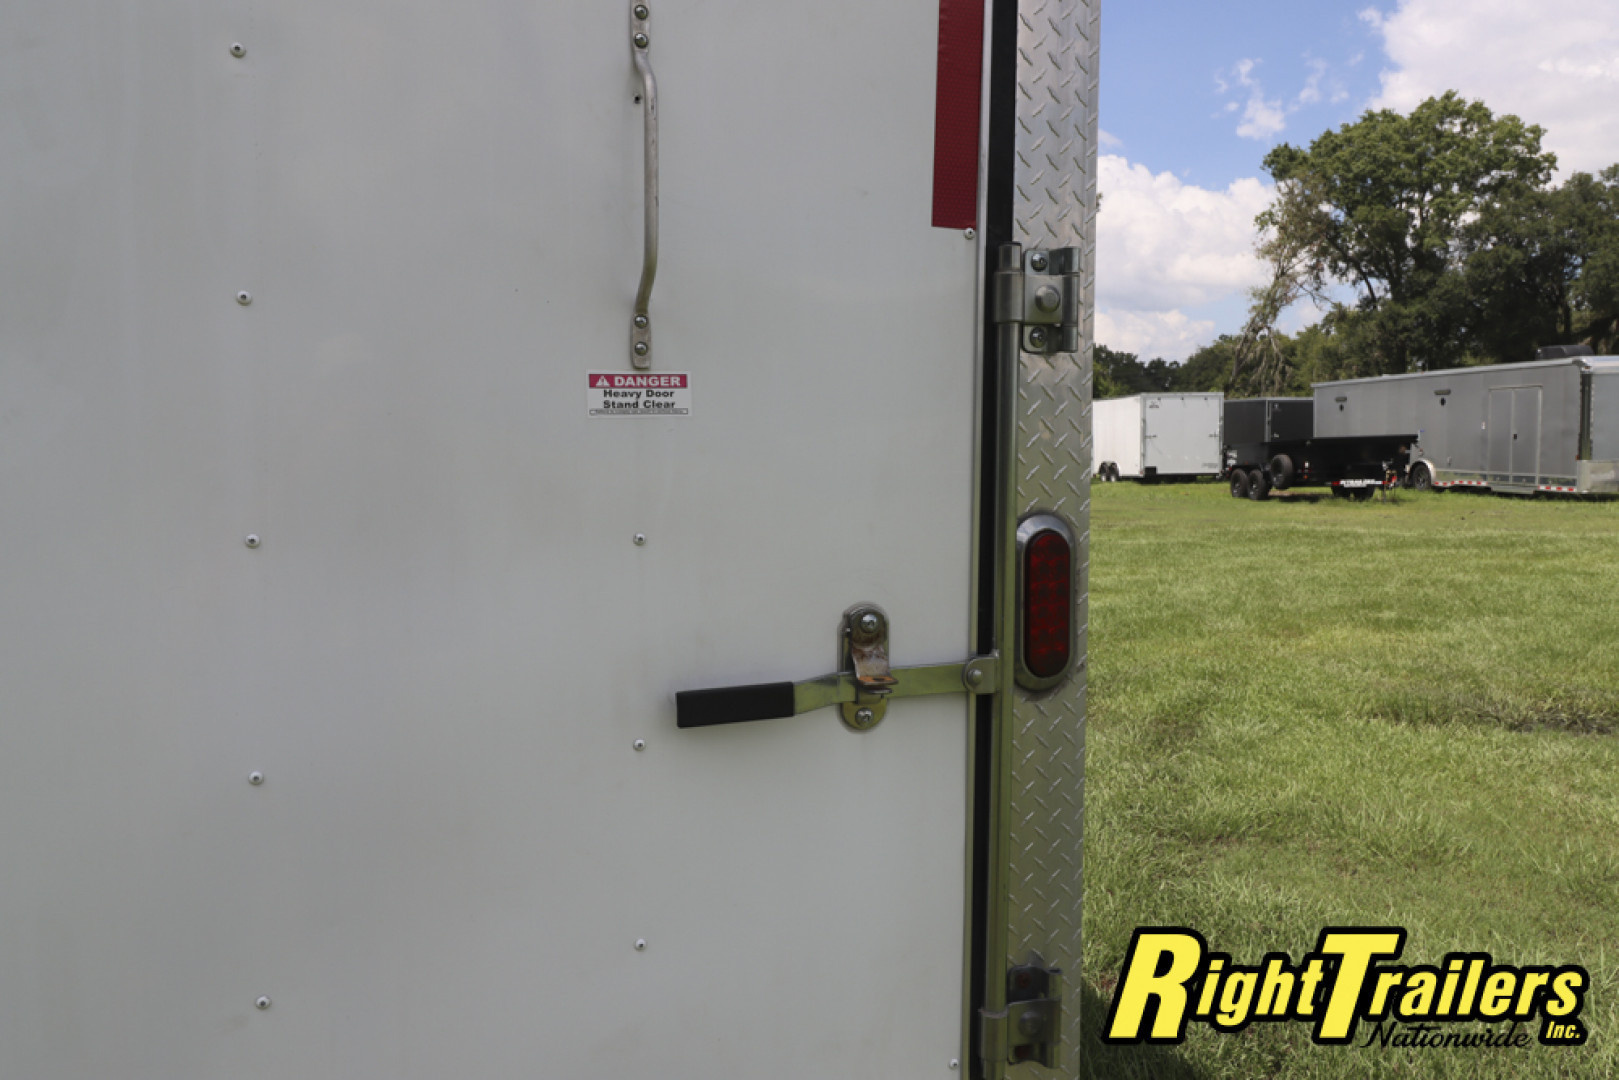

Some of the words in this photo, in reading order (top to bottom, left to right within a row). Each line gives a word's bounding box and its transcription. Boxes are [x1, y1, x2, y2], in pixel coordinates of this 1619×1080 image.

[614, 376, 681, 387] DANGER
[603, 389, 642, 400] Heavy
[646, 389, 675, 398] Door
[603, 399, 639, 409] Stand
[643, 399, 676, 409] Clear
